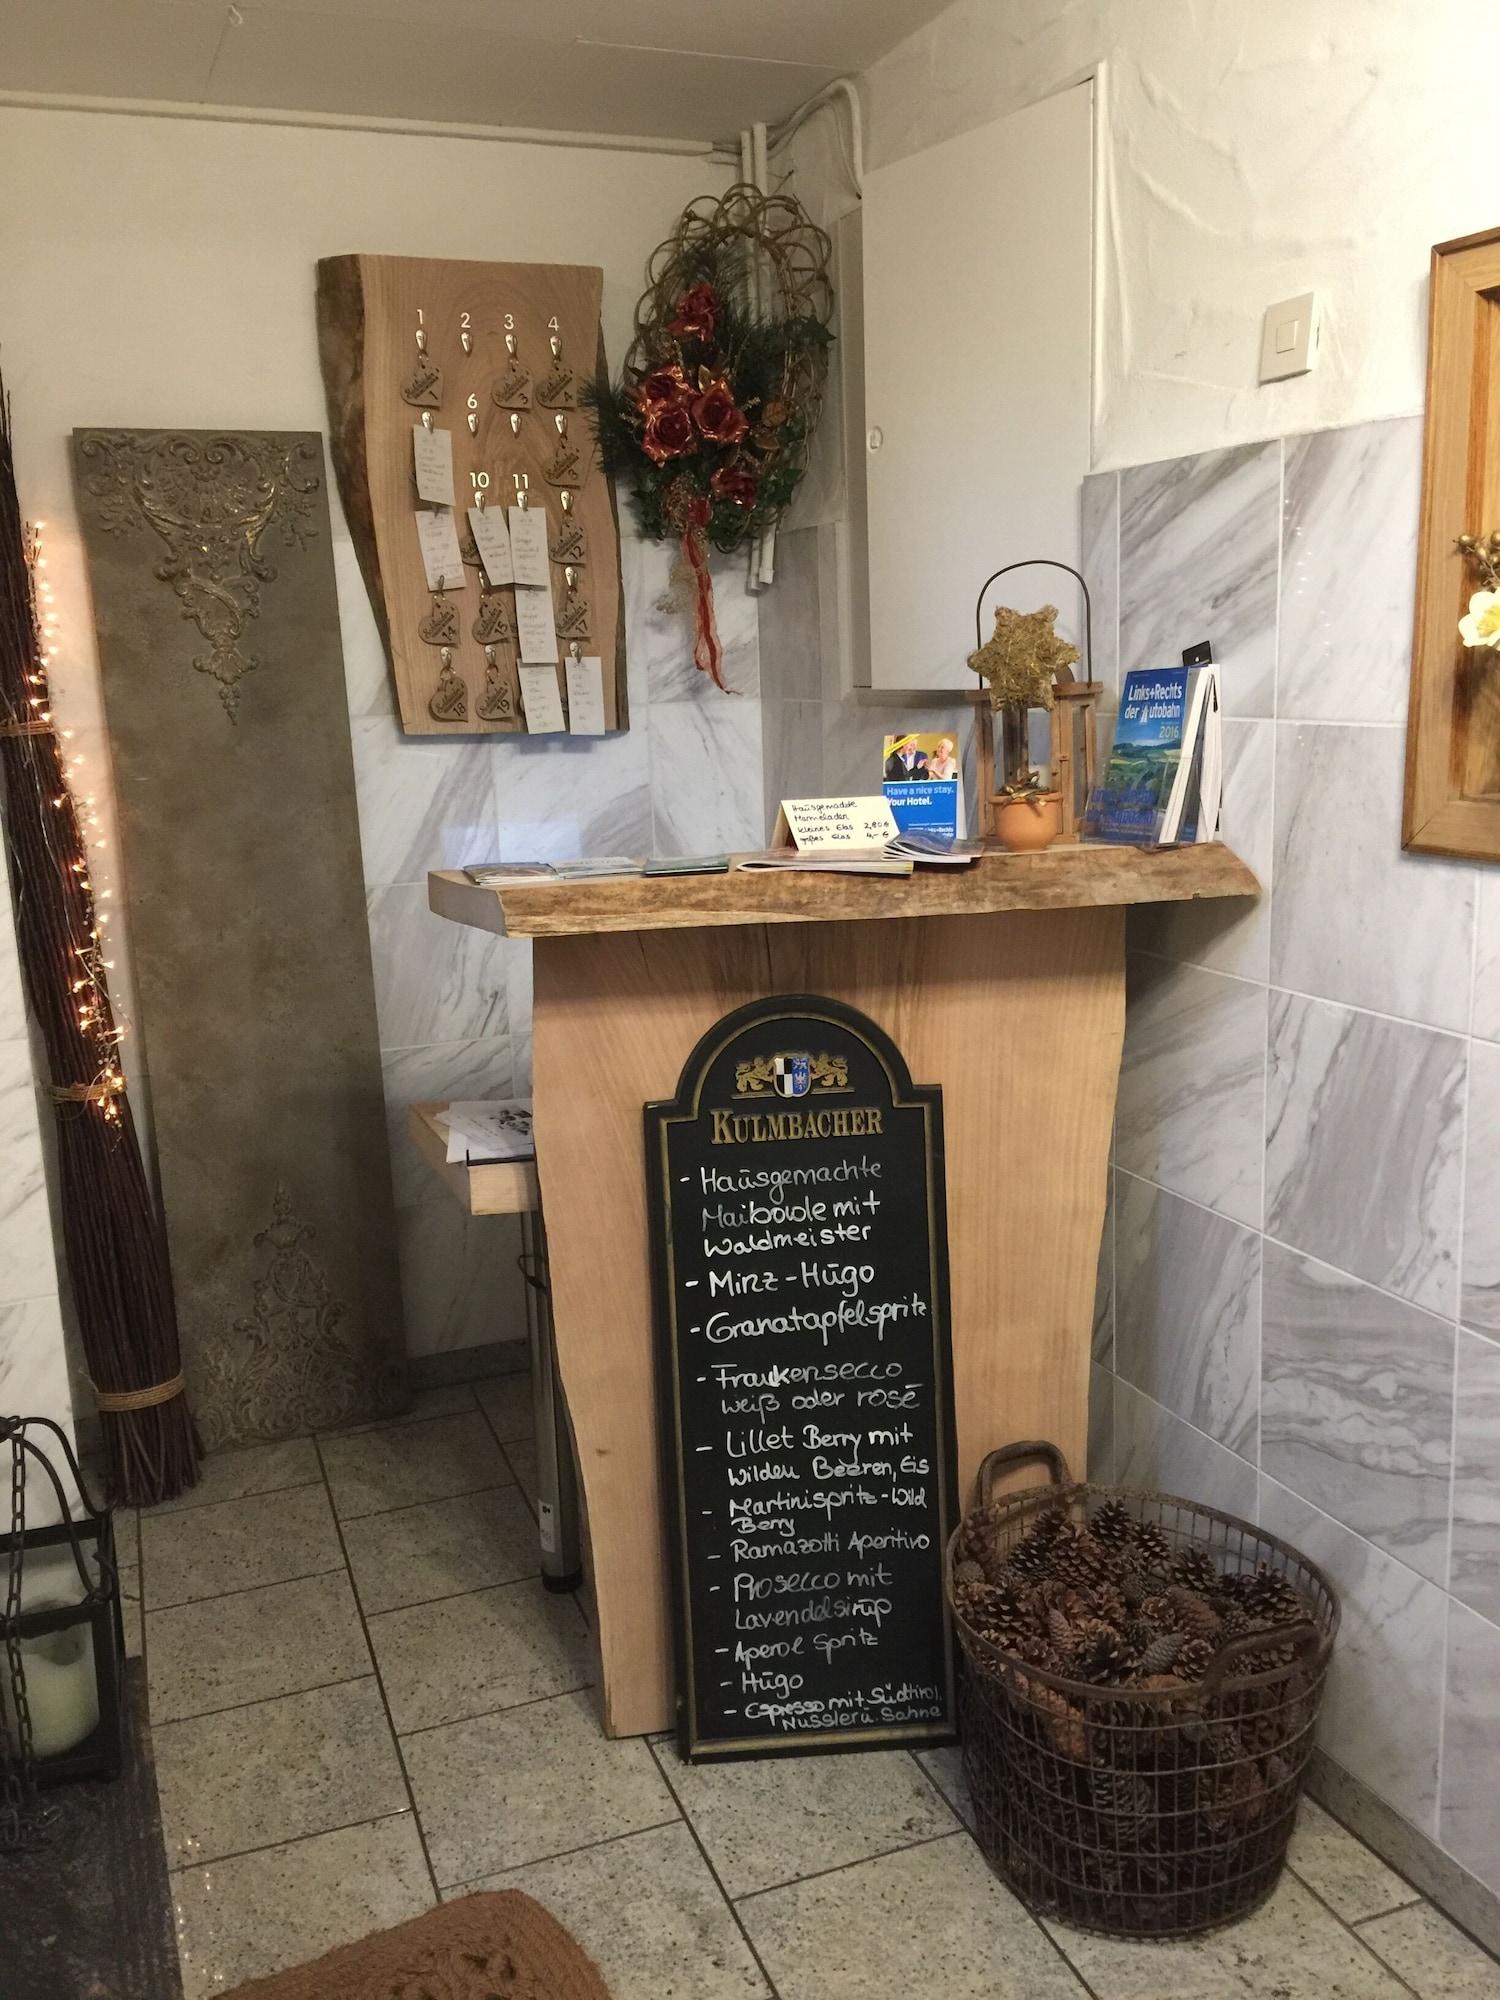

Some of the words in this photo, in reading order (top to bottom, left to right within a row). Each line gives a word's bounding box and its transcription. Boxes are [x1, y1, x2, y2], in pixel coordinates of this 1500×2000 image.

[416, 308, 424, 325] 1
[460, 312, 471, 329] 2
[504, 314, 515, 330] 3
[548, 316, 559, 331] 4
[467, 393, 478, 409] 6
[470, 472, 490, 488] 10
[512, 474, 529, 489] 11
[569, 545, 585, 560] 12
[494, 620, 508, 636] 15
[1128, 682, 1183, 701] Links+Rechts
[453, 702, 466, 717] 18
[496, 699, 510, 714] 19
[1124, 704, 1140, 719] der
[1159, 726, 1179, 738] 2016
[886, 787, 908, 796] Have
[915, 786, 933, 795] nice
[933, 785, 954, 795] stay.
[906, 796, 933, 806] Hotel.
[711, 1107, 884, 1145] KULMBACHER
[833, 1190, 880, 1217] mit
[792, 1388, 845, 1409] oder
[727, 1425, 794, 1457] Lillet
[803, 1424, 861, 1464] Berry
[868, 1422, 913, 1445] mit
[730, 1516, 795, 1537] Berry
[848, 1563, 892, 1586] mit
[829, 1690, 866, 1710] mit
[881, 1706, 941, 1721] Sahne
